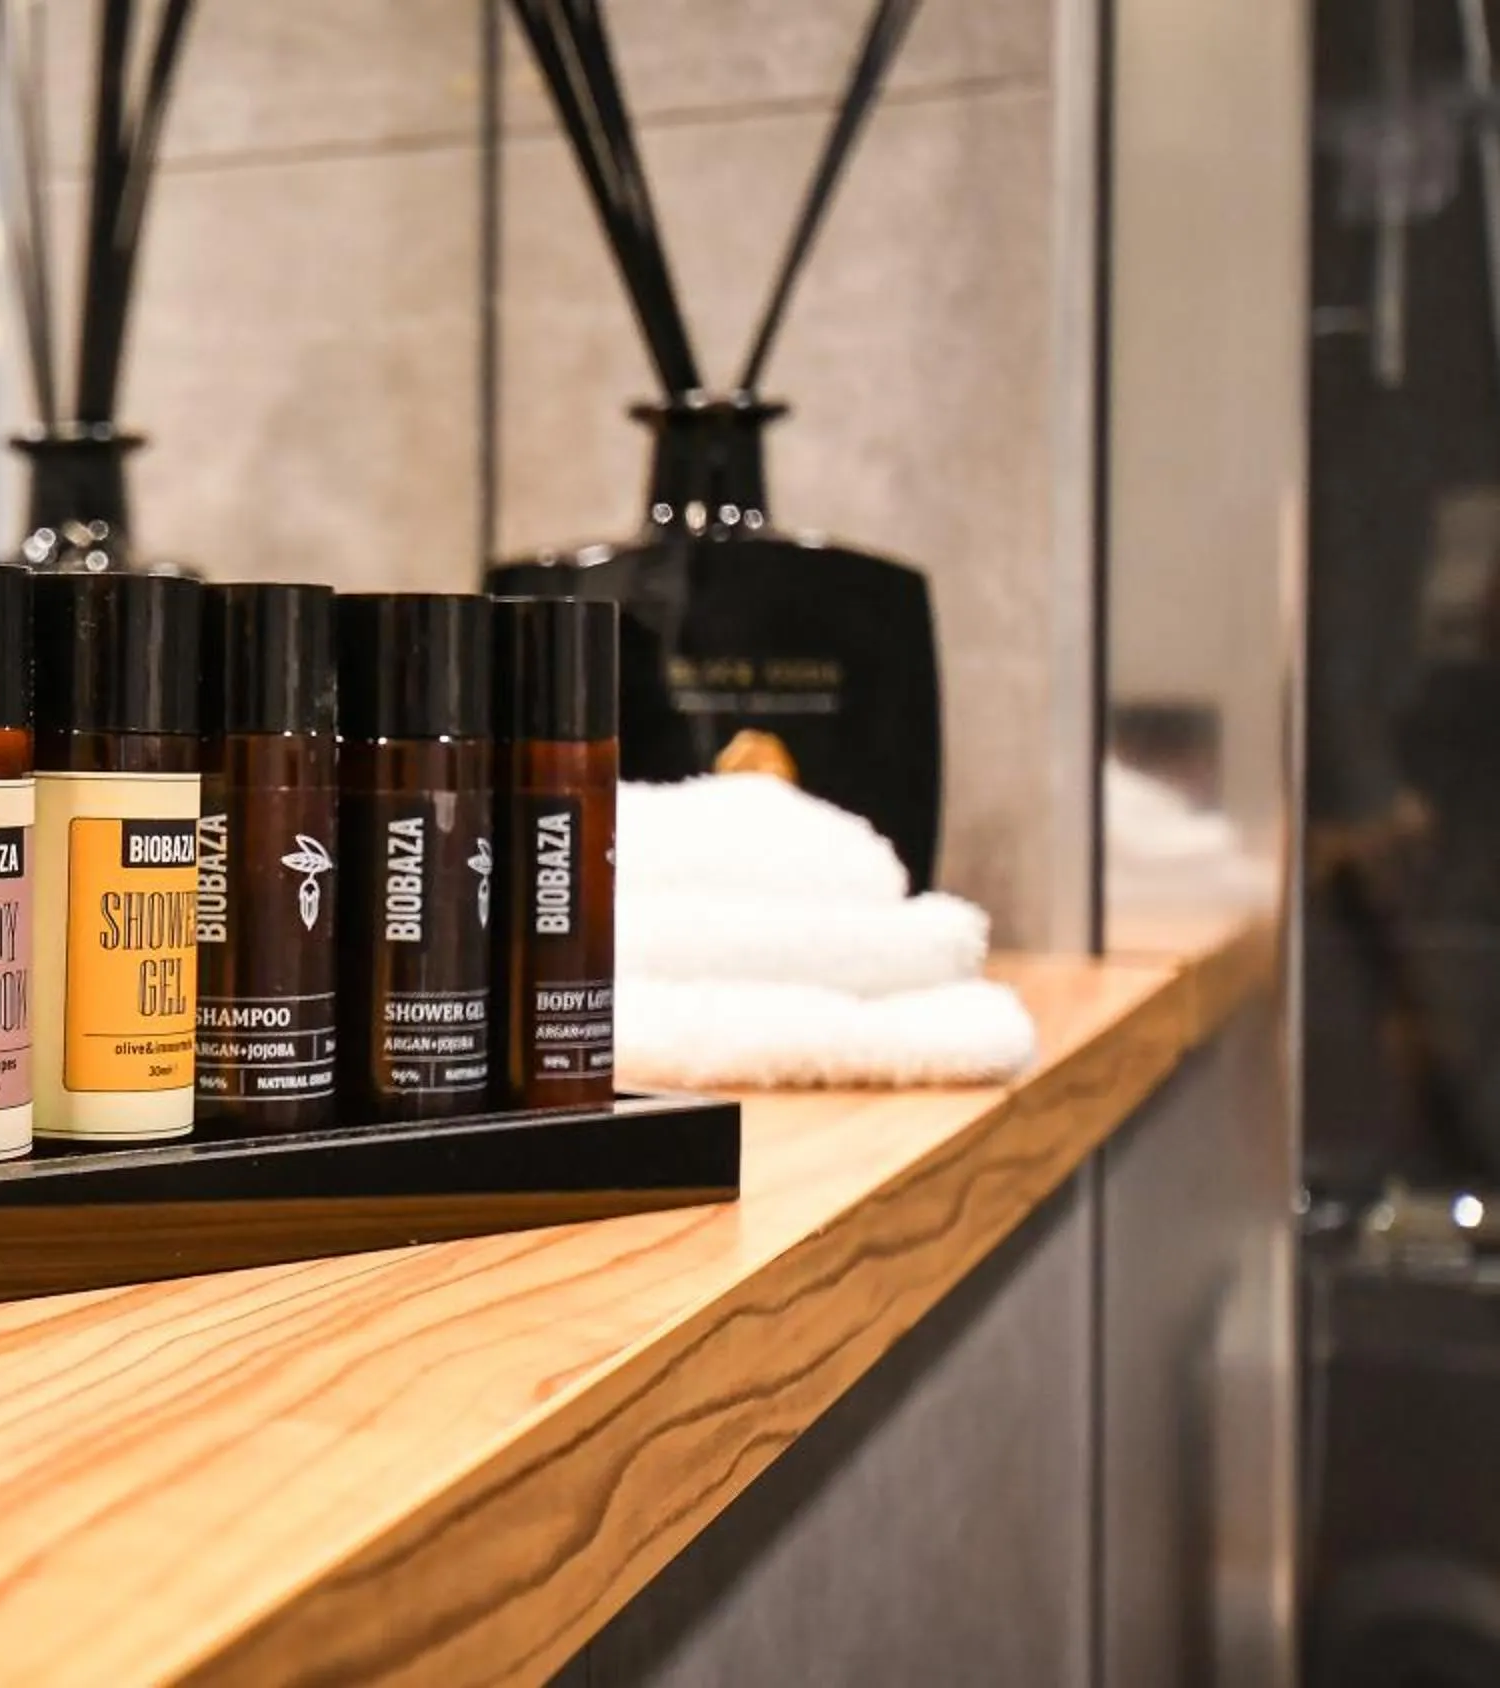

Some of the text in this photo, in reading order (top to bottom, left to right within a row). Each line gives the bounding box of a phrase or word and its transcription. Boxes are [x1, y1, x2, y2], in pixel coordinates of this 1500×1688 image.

[385, 816, 424, 944] BIOBAZA
[535, 811, 572, 936] BIOBAZA
[137, 958, 186, 1018] GEL
[384, 1002, 464, 1022] SHOWER
[537, 991, 584, 1011] BODY
